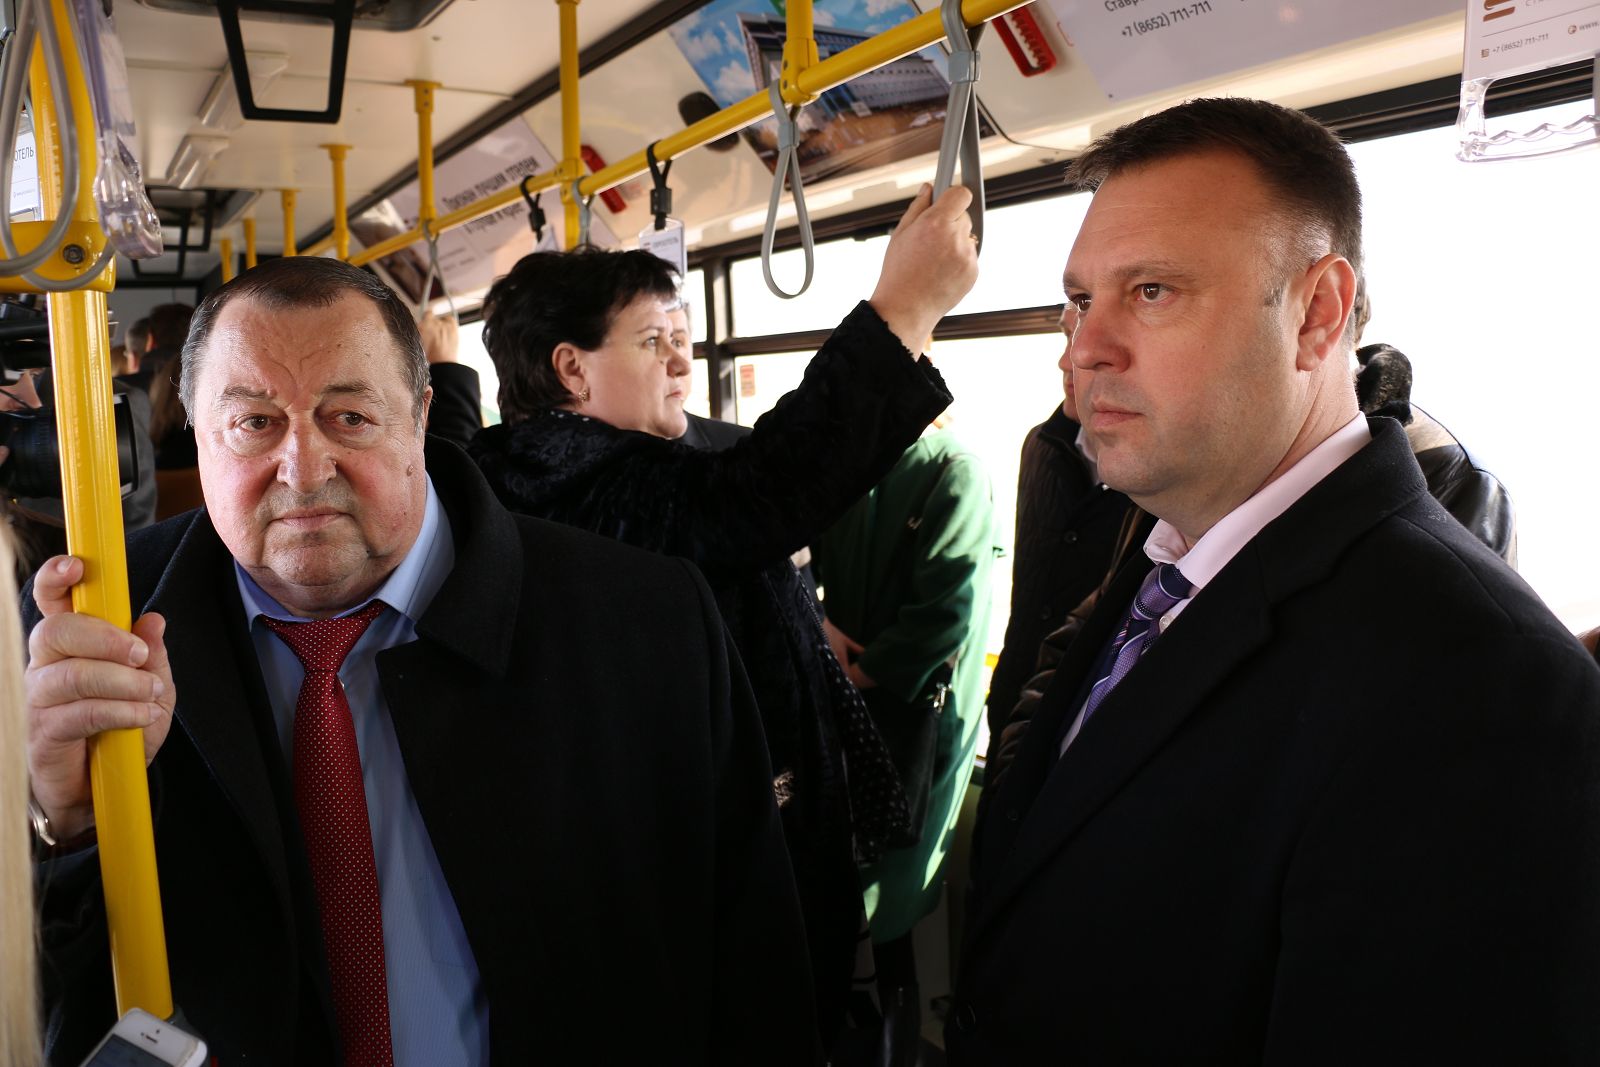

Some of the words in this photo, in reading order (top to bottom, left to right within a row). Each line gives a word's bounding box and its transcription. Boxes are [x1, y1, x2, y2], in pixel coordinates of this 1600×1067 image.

[1121, 26, 1133, 37] +7
[1133, 12, 1171, 36] (8652)
[1170, 1, 1213, 23] 711-711
